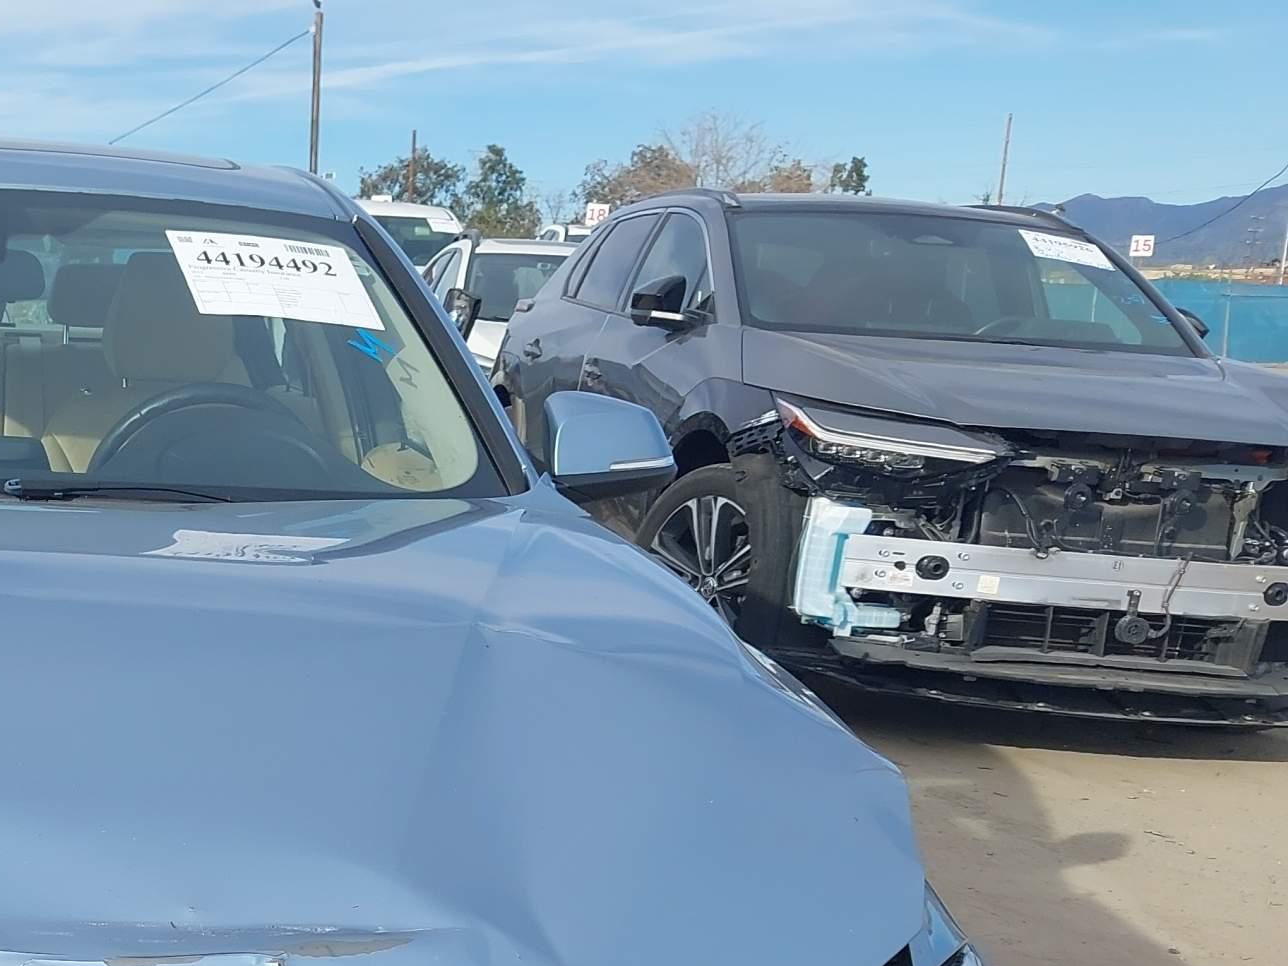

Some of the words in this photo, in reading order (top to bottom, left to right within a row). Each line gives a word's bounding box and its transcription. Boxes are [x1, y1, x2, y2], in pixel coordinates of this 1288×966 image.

[588, 208, 607, 221] 18
[1132, 239, 1152, 252] 15
[196, 250, 337, 277] 44194492
